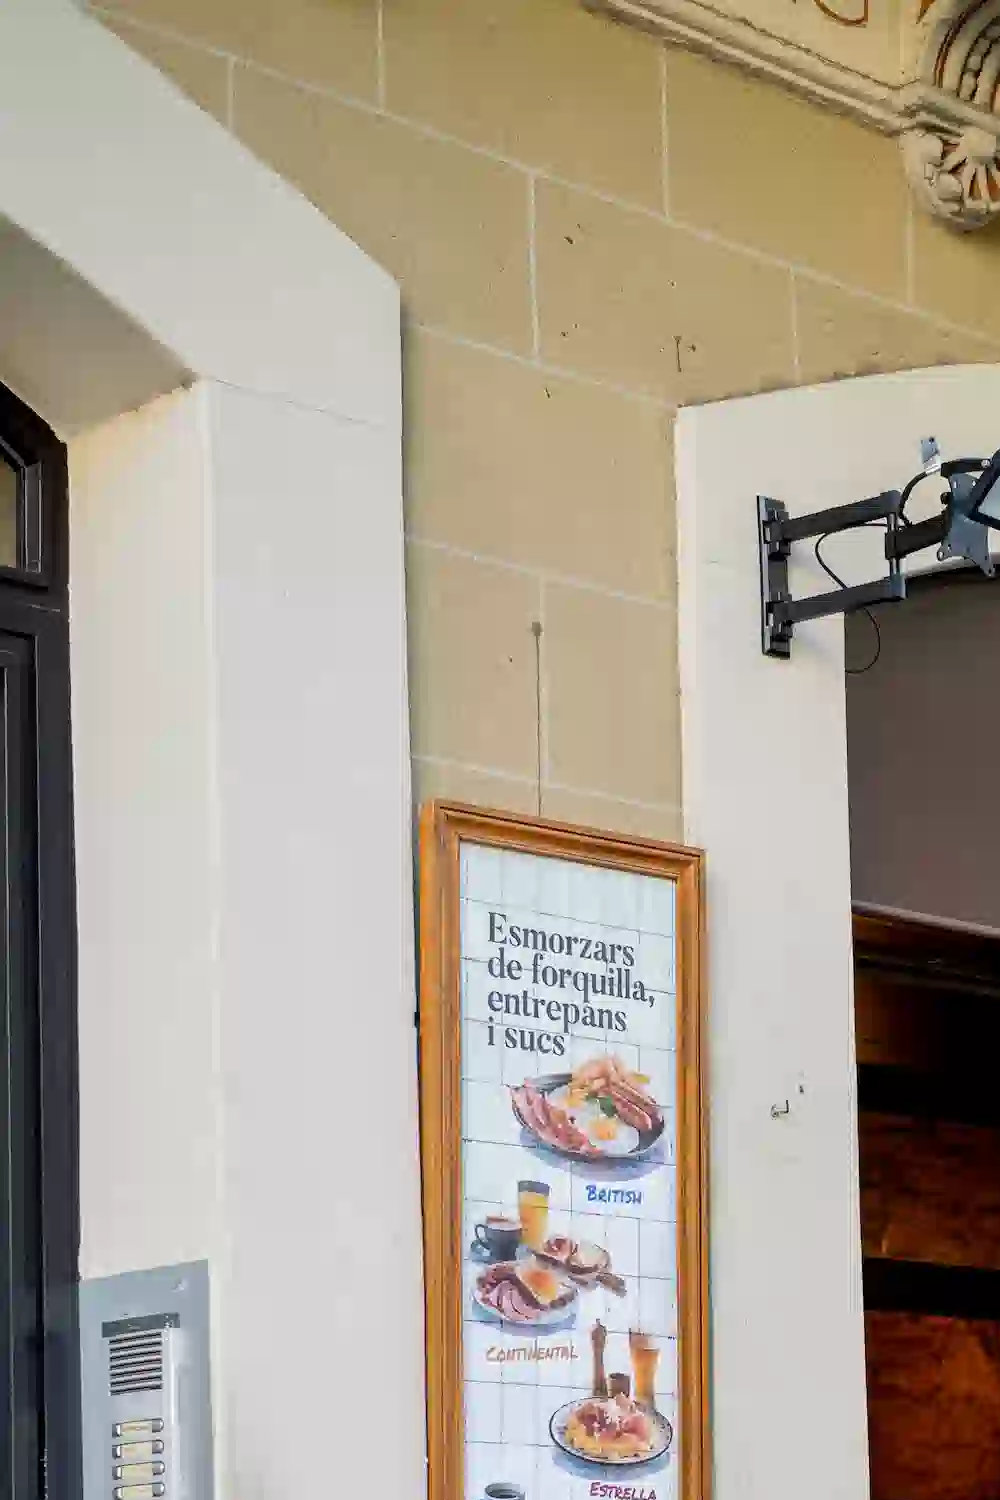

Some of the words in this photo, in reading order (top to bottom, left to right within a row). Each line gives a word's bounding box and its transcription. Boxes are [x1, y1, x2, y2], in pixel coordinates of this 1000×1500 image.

[487, 911, 636, 968] Esmorzars
[487, 947, 523, 981] de
[532, 953, 656, 1007] forquilla,
[487, 987, 628, 1035] entrepans
[487, 1017, 497, 1047] i
[504, 1027, 566, 1057] sucs
[585, 1184, 642, 1205] BRITISH
[486, 1345, 579, 1363] CONTINENTAL
